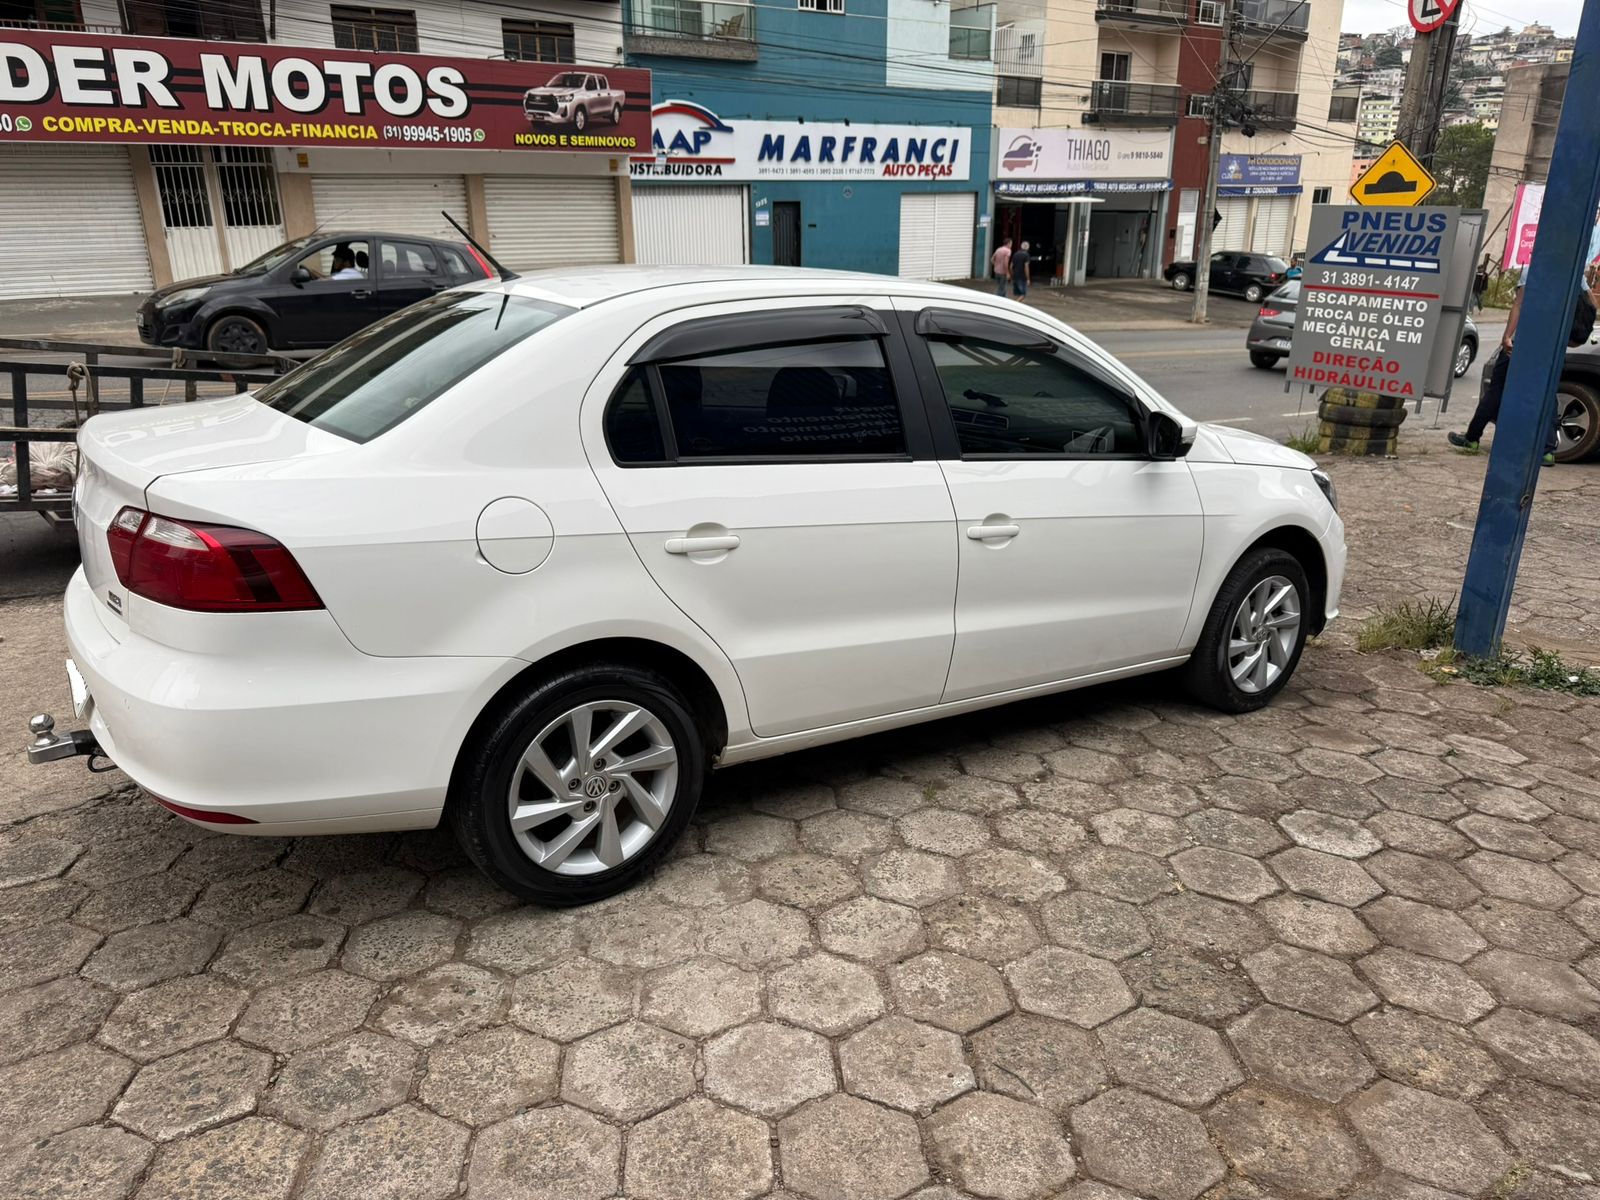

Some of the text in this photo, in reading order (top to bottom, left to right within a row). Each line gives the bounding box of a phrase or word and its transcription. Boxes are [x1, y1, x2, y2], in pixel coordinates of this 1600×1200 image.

[0, 42, 469, 118] DER MOTOS
[42, 115, 473, 143] COMPRA-VENDA-TROCA-FINANCIA (31) 99945-1905
[515, 132, 637, 149] NOVOS E SEMINOVOS
[757, 133, 960, 164] MARFRANCI
[1067, 139, 1111, 161] THIAGO
[882, 163, 953, 180] AUTO PEÇAS
[1009, 183, 1025, 192] THIAGO
[1093, 182, 1108, 190] THIAGO
[1341, 211, 1448, 233] PNEUS
[1321, 271, 1337, 284] 31
[1307, 291, 1428, 313] ESCAPAMENTO
[1306, 306, 1425, 328] TROCA DE ÓLEO
[1302, 320, 1423, 344] MECÂNICA EM
[1330, 336, 1386, 353] GERAL
[1312, 351, 1400, 374] DIREÇÃO
[1294, 365, 1414, 395] HIDRÁULICA
